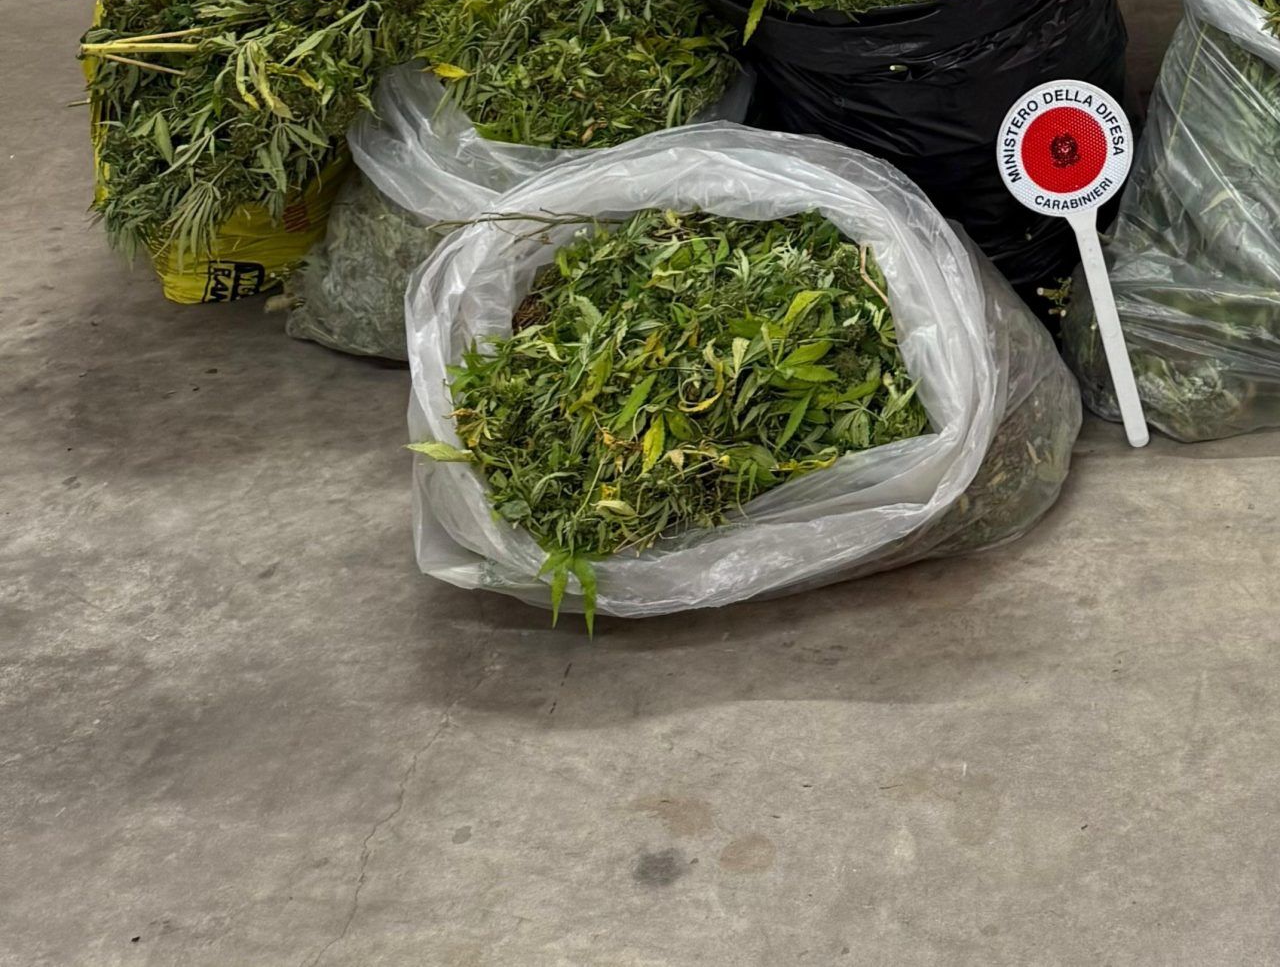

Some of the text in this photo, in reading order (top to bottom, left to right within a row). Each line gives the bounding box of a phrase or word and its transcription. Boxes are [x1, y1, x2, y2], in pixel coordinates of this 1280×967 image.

[1003, 89, 1124, 183] MINISTERO DELLA DIFESA
[1034, 177, 1113, 210] CARABINIERI
